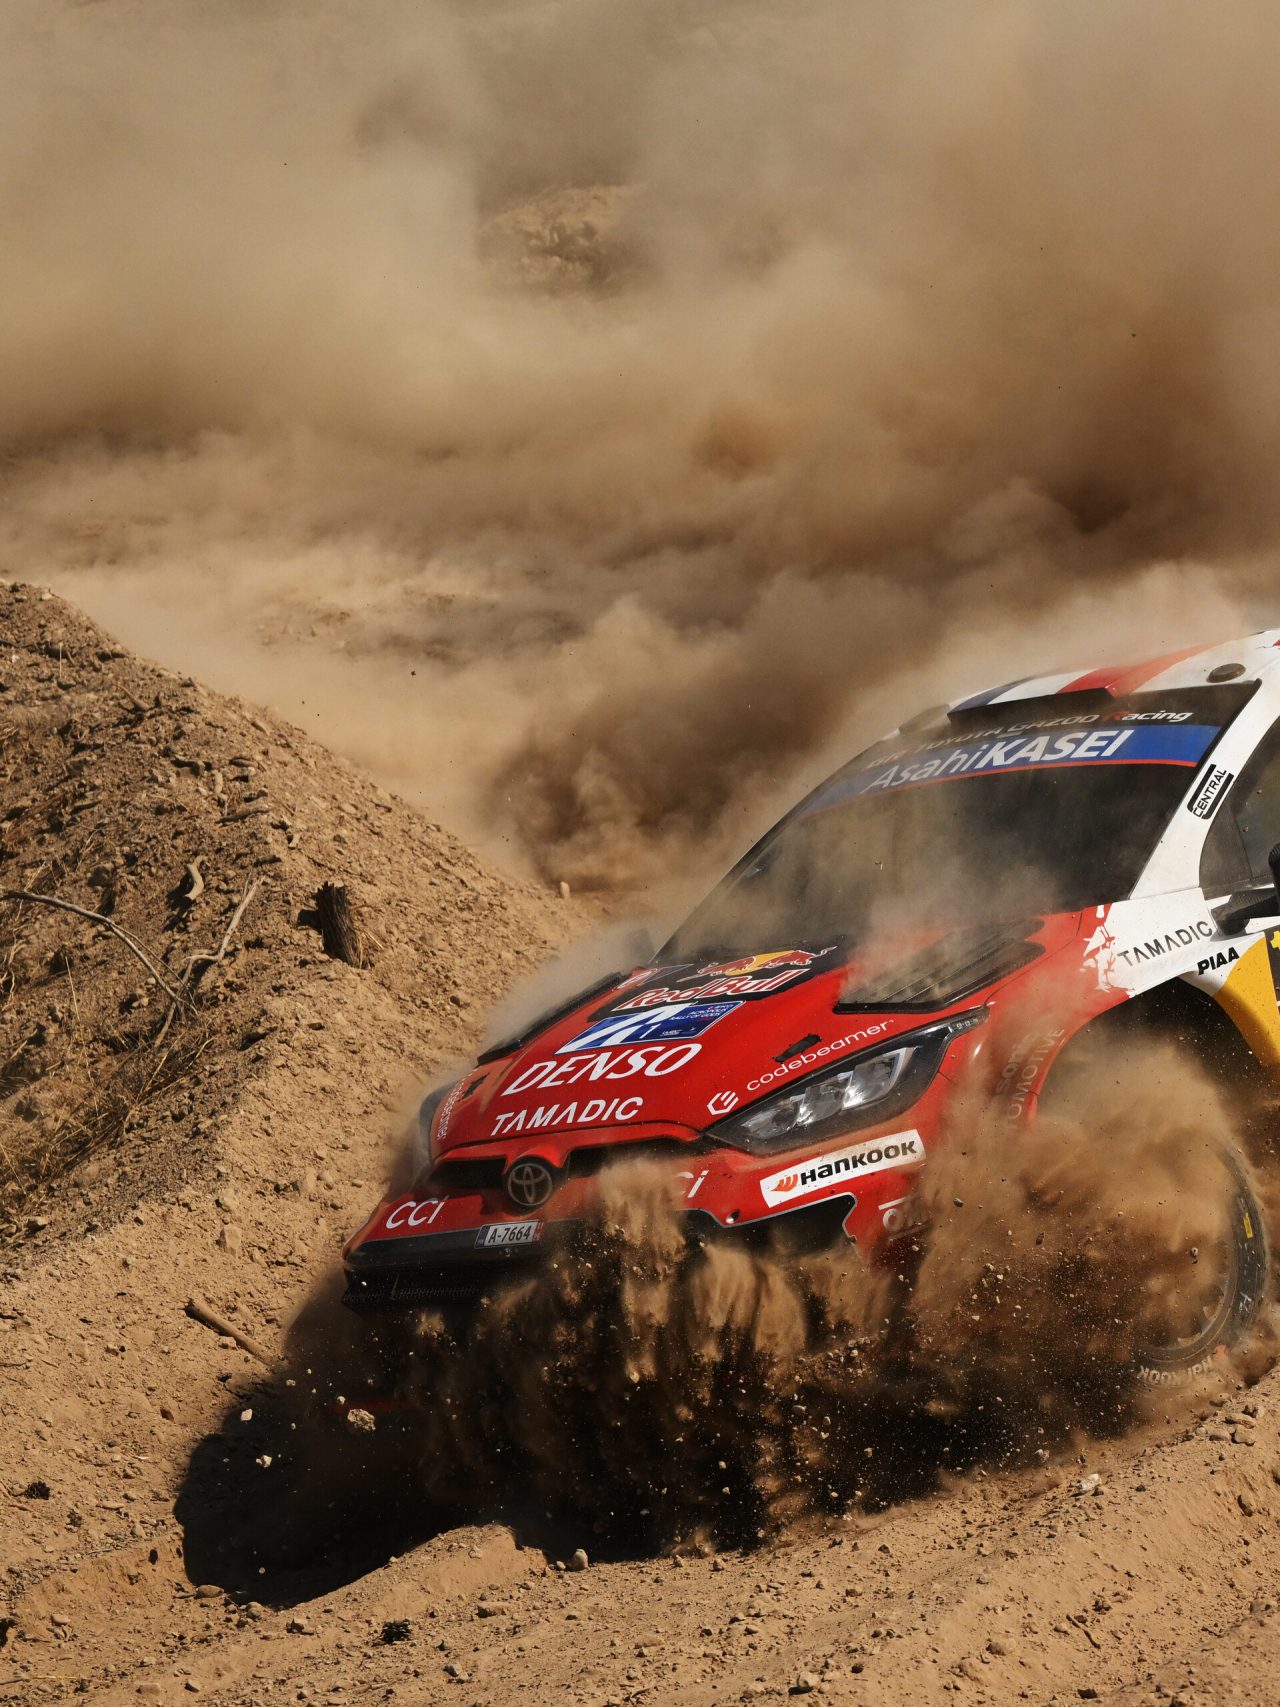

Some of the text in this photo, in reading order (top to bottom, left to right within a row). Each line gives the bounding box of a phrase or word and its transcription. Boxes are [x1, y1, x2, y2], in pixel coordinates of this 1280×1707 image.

[1193, 770, 1227, 818] CENTRAL
[1117, 920, 1213, 966] TAMADIC
[1197, 946, 1240, 975] PIAA
[500, 1043, 703, 1097] DENSO
[747, 1020, 891, 1091] codebeamer
[491, 1097, 643, 1137] TAMADIC
[488, 1225, 532, 1244] A-7664
